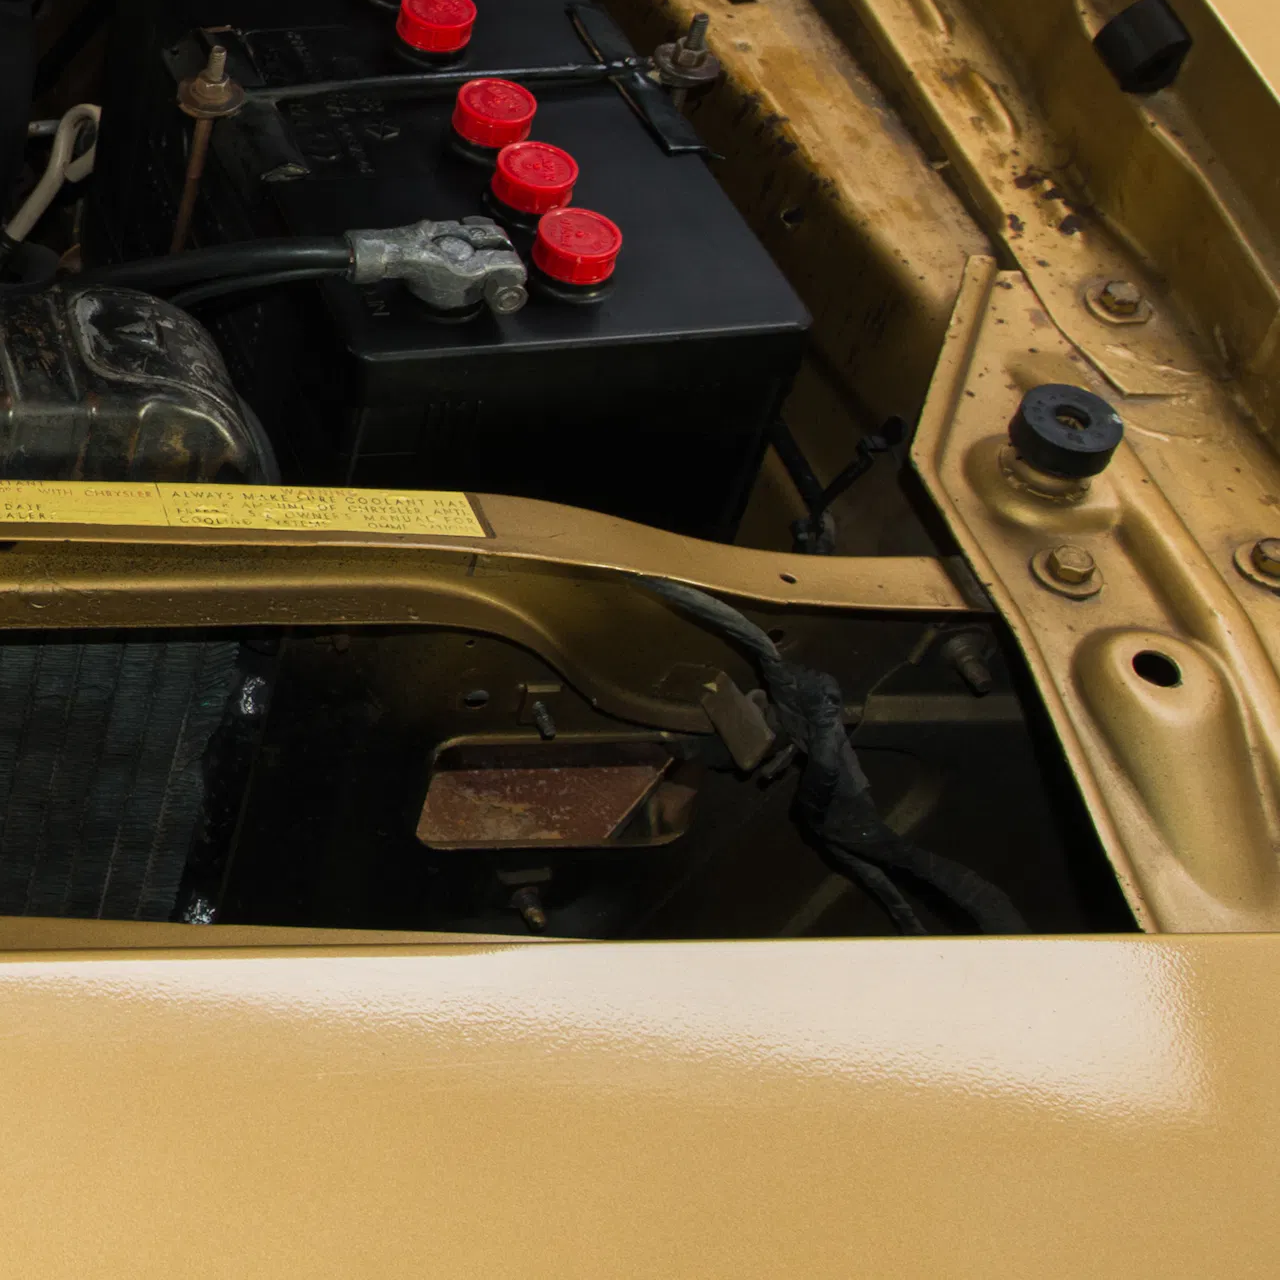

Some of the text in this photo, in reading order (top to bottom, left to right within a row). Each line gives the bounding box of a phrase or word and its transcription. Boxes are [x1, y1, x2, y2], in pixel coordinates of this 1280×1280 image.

[38, 488, 73, 496] WITH
[84, 489, 152, 498] CHRYSLER
[172, 491, 234, 500] ALWAYS
[243, 492, 290, 502] MAKE
[345, 496, 426, 507] COOLANT
[433, 499, 468, 509] HAS
[347, 505, 423, 515] CHRYSLER
[364, 515, 435, 524] MANUAL
[444, 517, 476, 526] FOR
